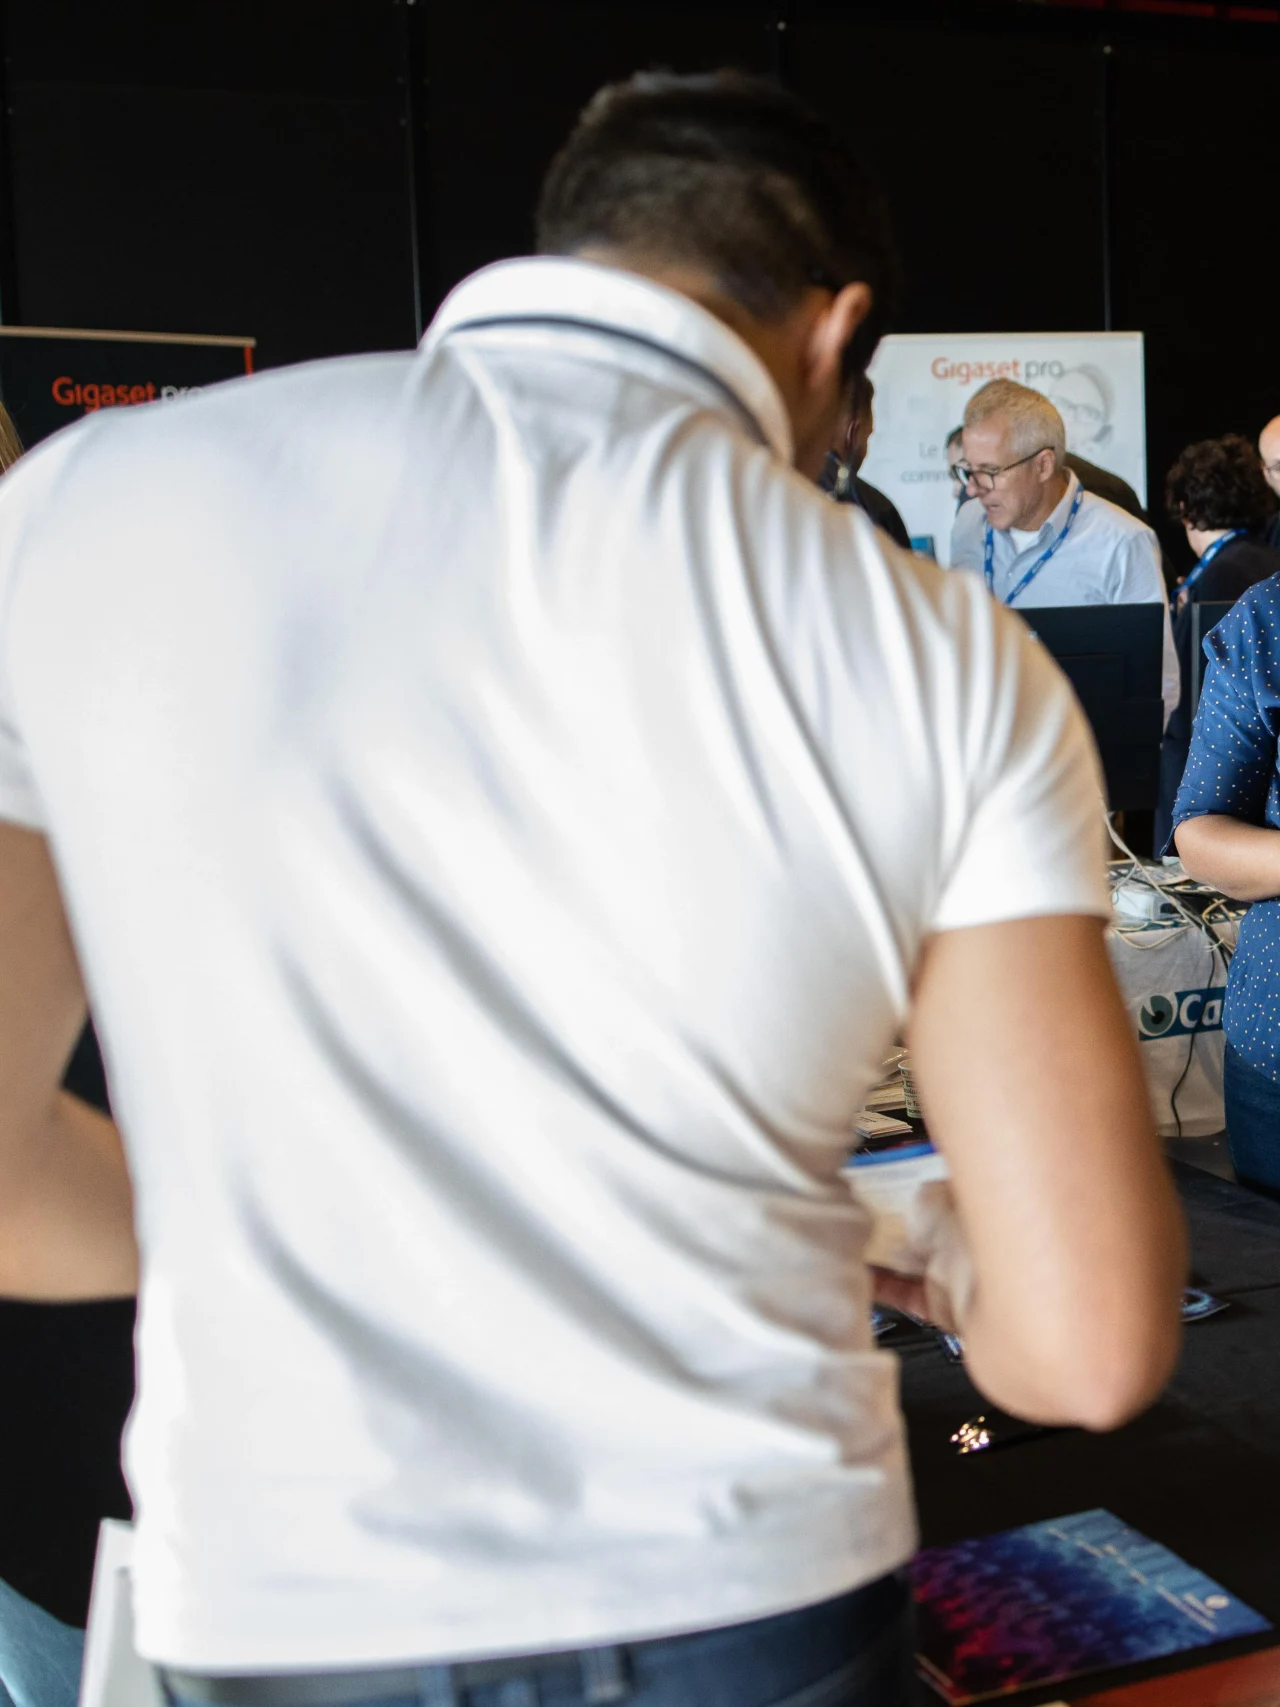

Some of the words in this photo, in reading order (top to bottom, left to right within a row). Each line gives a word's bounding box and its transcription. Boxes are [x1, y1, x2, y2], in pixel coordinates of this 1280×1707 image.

[931, 356, 1021, 386] Gigaset
[1024, 359, 1065, 383] pro
[51, 376, 156, 413] Gigaset
